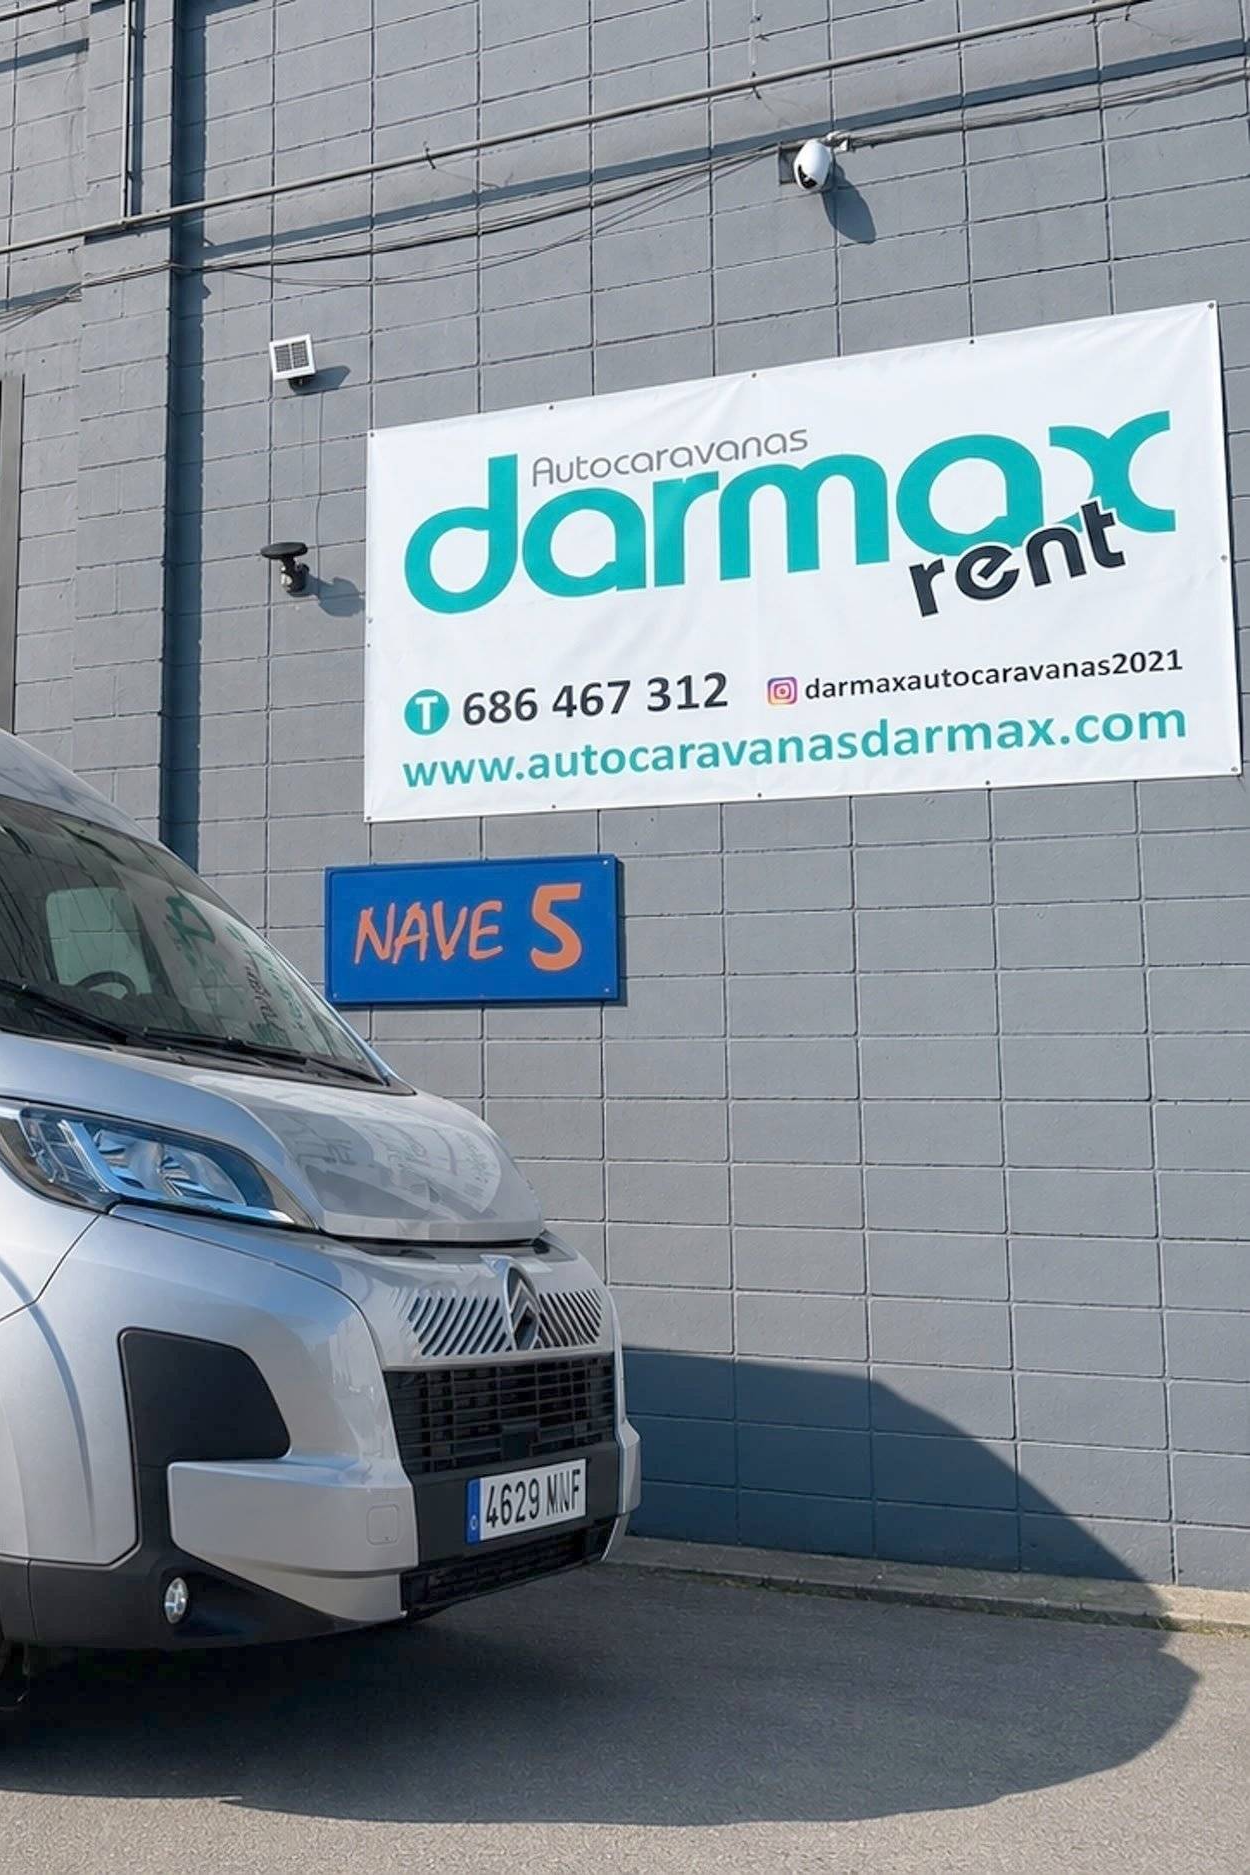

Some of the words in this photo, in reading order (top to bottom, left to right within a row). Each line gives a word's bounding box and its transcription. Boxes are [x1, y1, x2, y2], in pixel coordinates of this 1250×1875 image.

[532, 426, 809, 488] Autocaravanas
[404, 410, 1176, 615] darmax
[908, 501, 1126, 617] rent
[463, 687, 538, 726] 686
[552, 680, 631, 719] 467
[647, 672, 729, 712] 312
[805, 649, 1184, 701] darmaxautocaravanas2021
[403, 708, 1186, 787] www.autocaravanasdarmax.com
[354, 900, 503, 964] NAVE
[530, 882, 582, 972] 5
[486, 1478, 540, 1528] 4629
